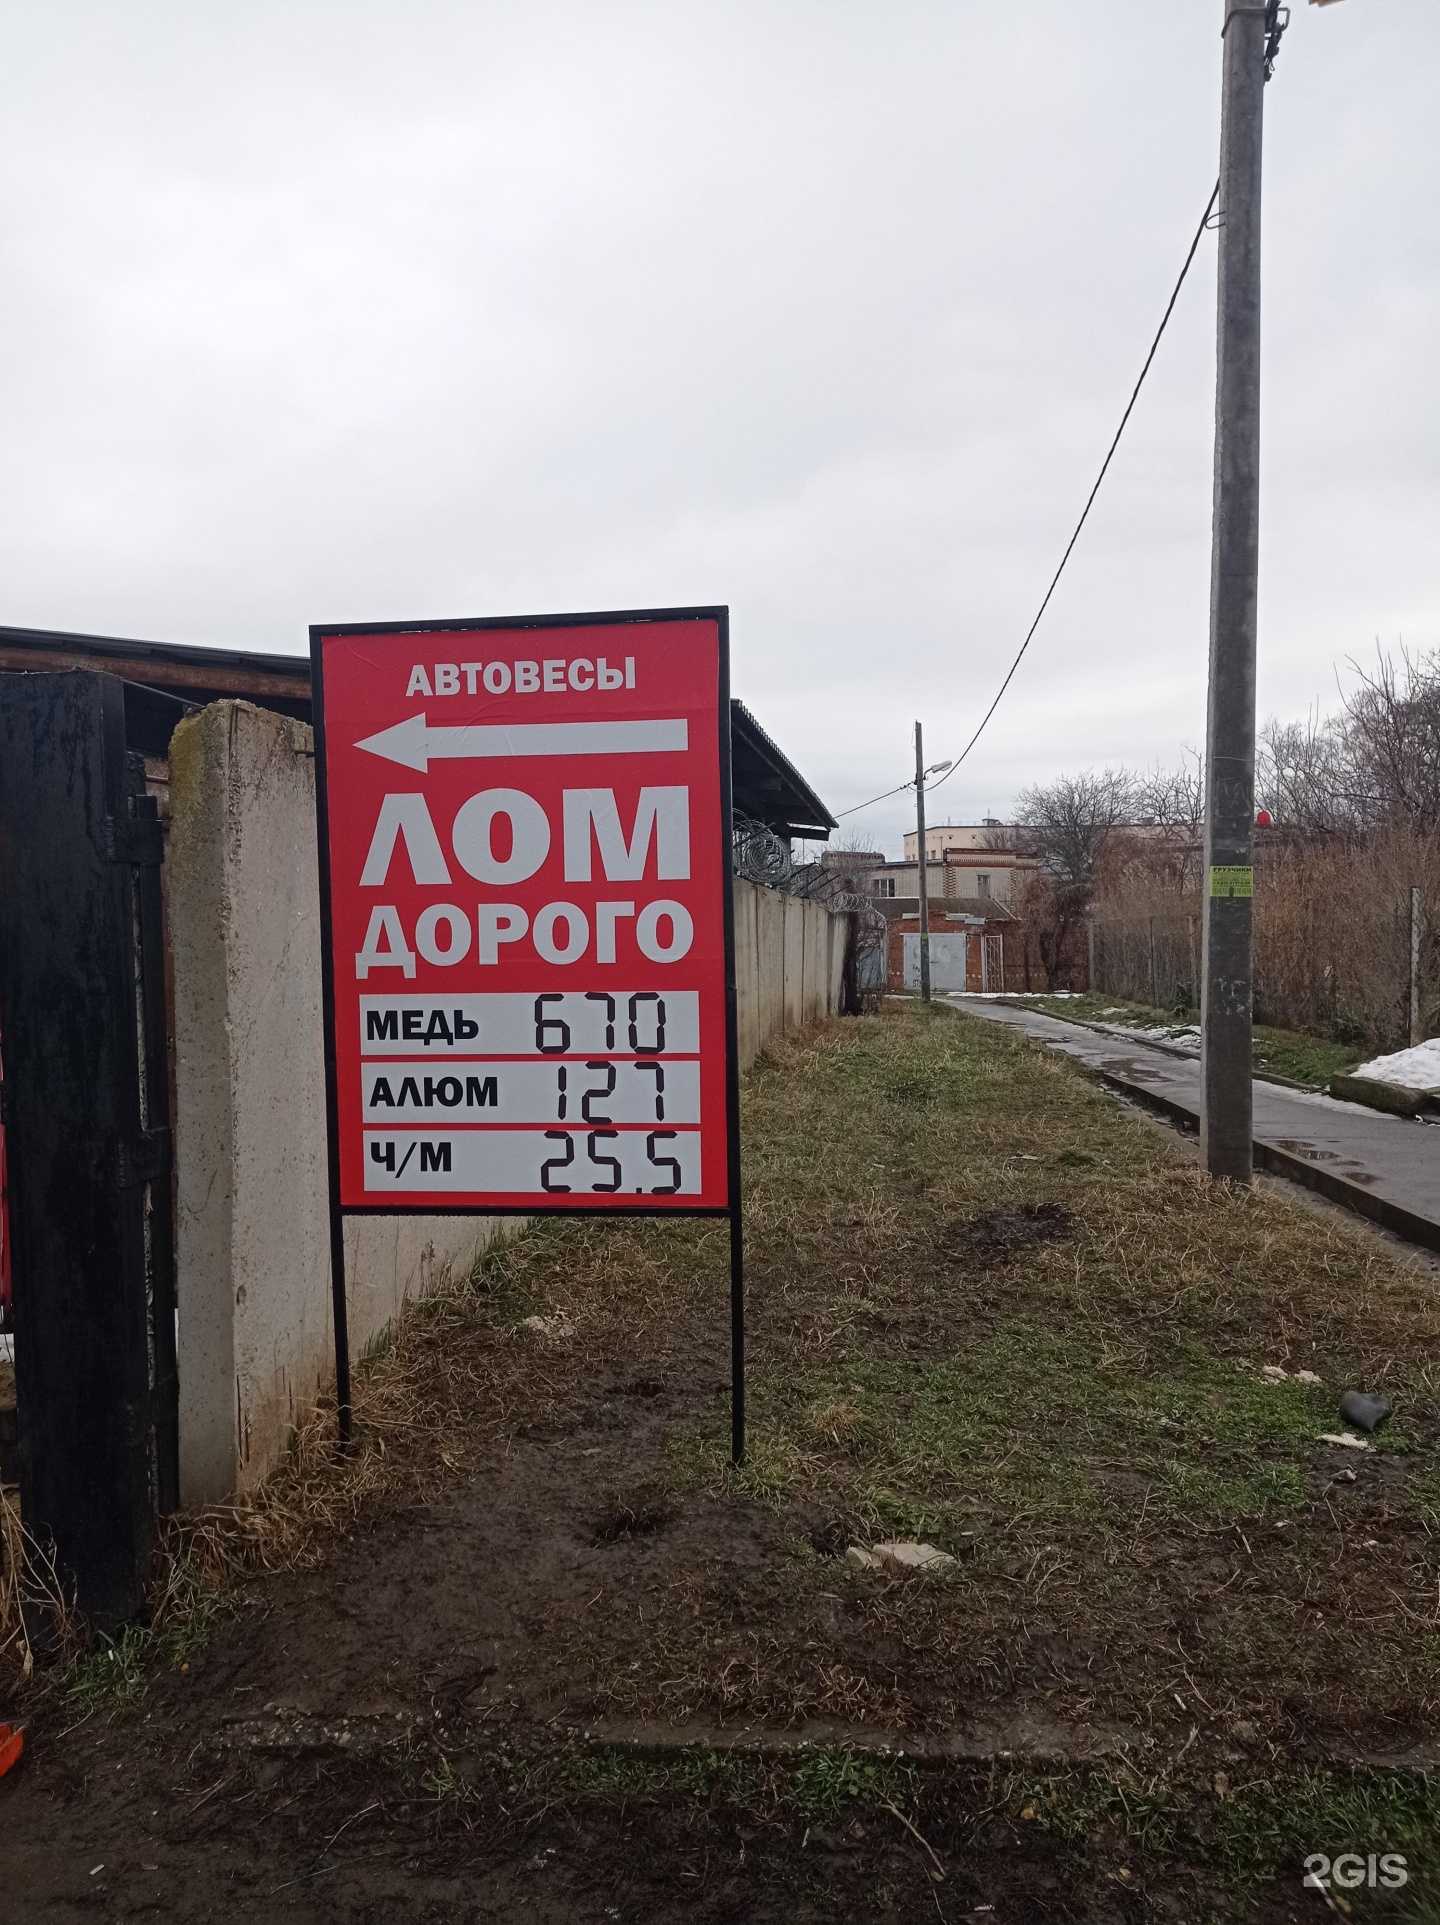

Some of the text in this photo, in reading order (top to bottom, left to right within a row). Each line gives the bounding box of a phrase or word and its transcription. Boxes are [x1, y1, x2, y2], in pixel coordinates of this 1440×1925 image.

[405, 656, 636, 697] АВТОВЕСЫ
[358, 785, 691, 887] ЛОМ
[355, 899, 694, 980] ДОРОГО
[366, 992, 667, 1054] МЕДЬ 670
[369, 1061, 665, 1124] АЛЮМ 127
[370, 1130, 682, 1195] Ч/М 25.5
